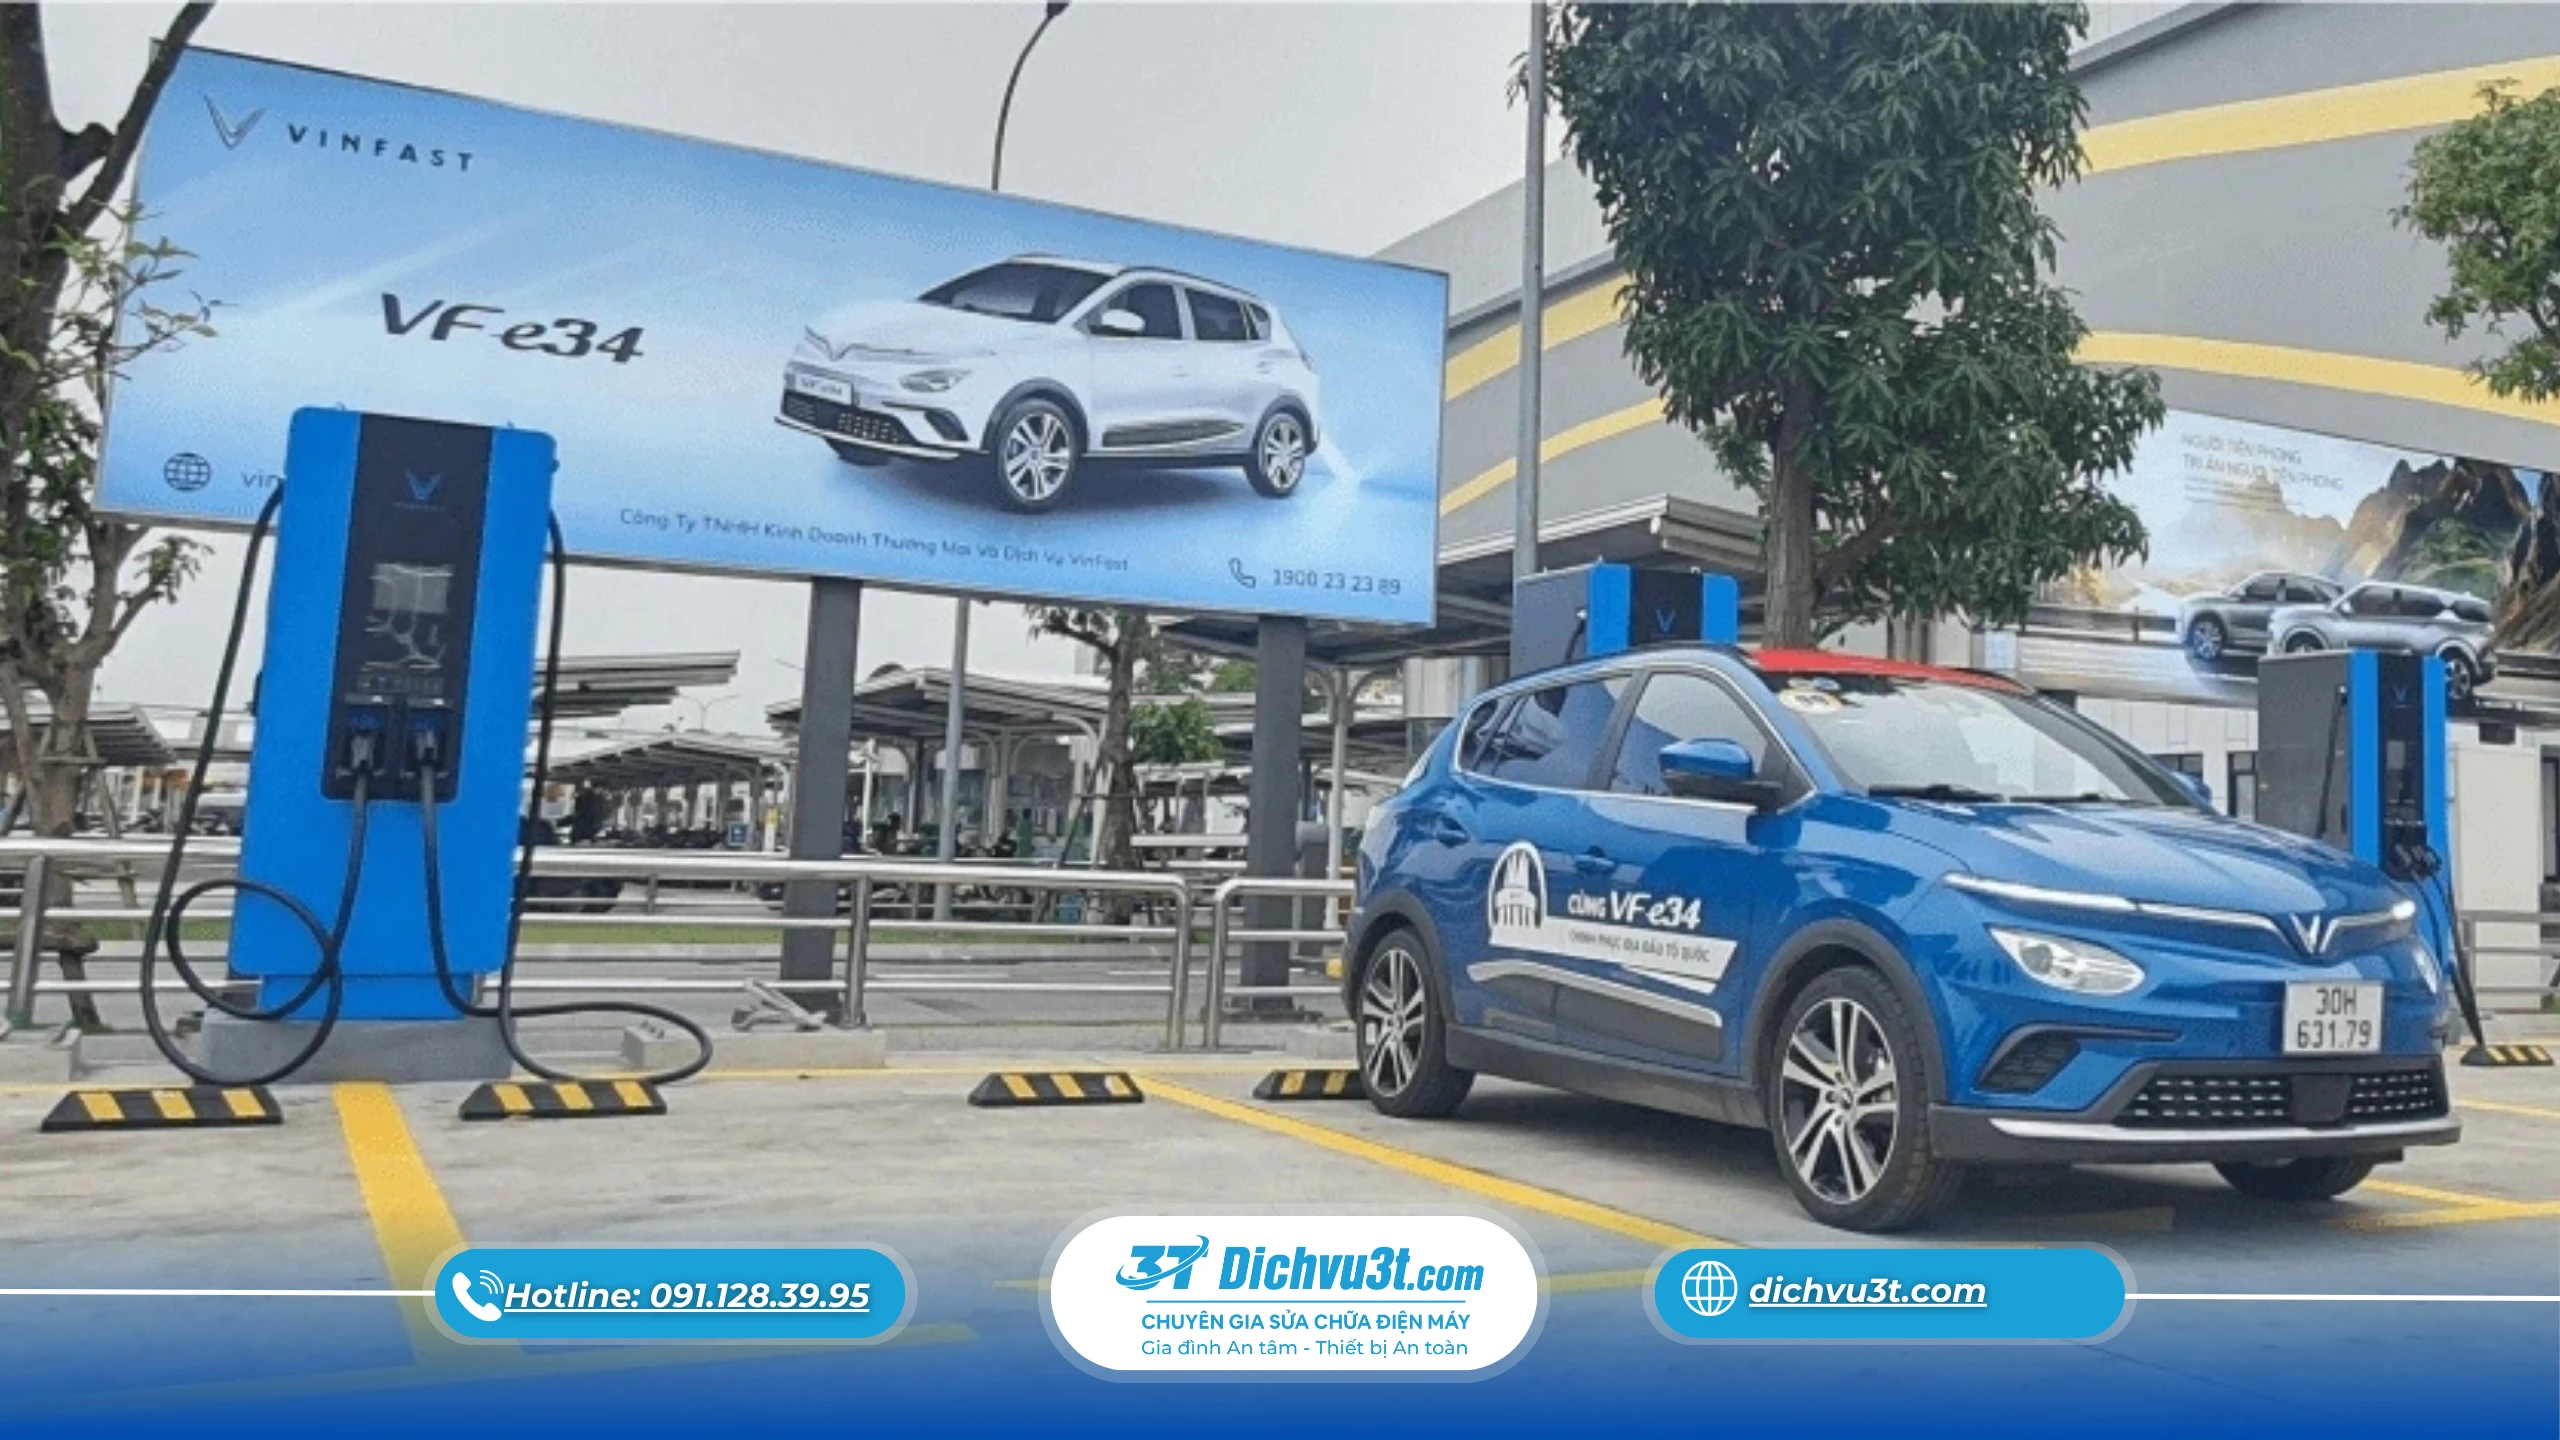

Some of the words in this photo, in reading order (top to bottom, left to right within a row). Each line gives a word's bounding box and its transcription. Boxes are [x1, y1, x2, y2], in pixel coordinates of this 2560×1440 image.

[287, 123, 474, 172] VINFAST
[620, 507, 669, 532] Công
[676, 513, 697, 534] Ty
[704, 516, 760, 535] TNHH
[764, 522, 803, 541] Kinh
[808, 526, 867, 547] Doanh
[1273, 568, 1318, 588] 1900
[1323, 572, 1346, 590] 23
[1352, 575, 1374, 593] 23
[1378, 578, 1401, 596] 89
[1567, 888, 1606, 919] CÙNG
[2315, 986, 2357, 1016] 30H
[2296, 1019, 2372, 1049] 631.79
